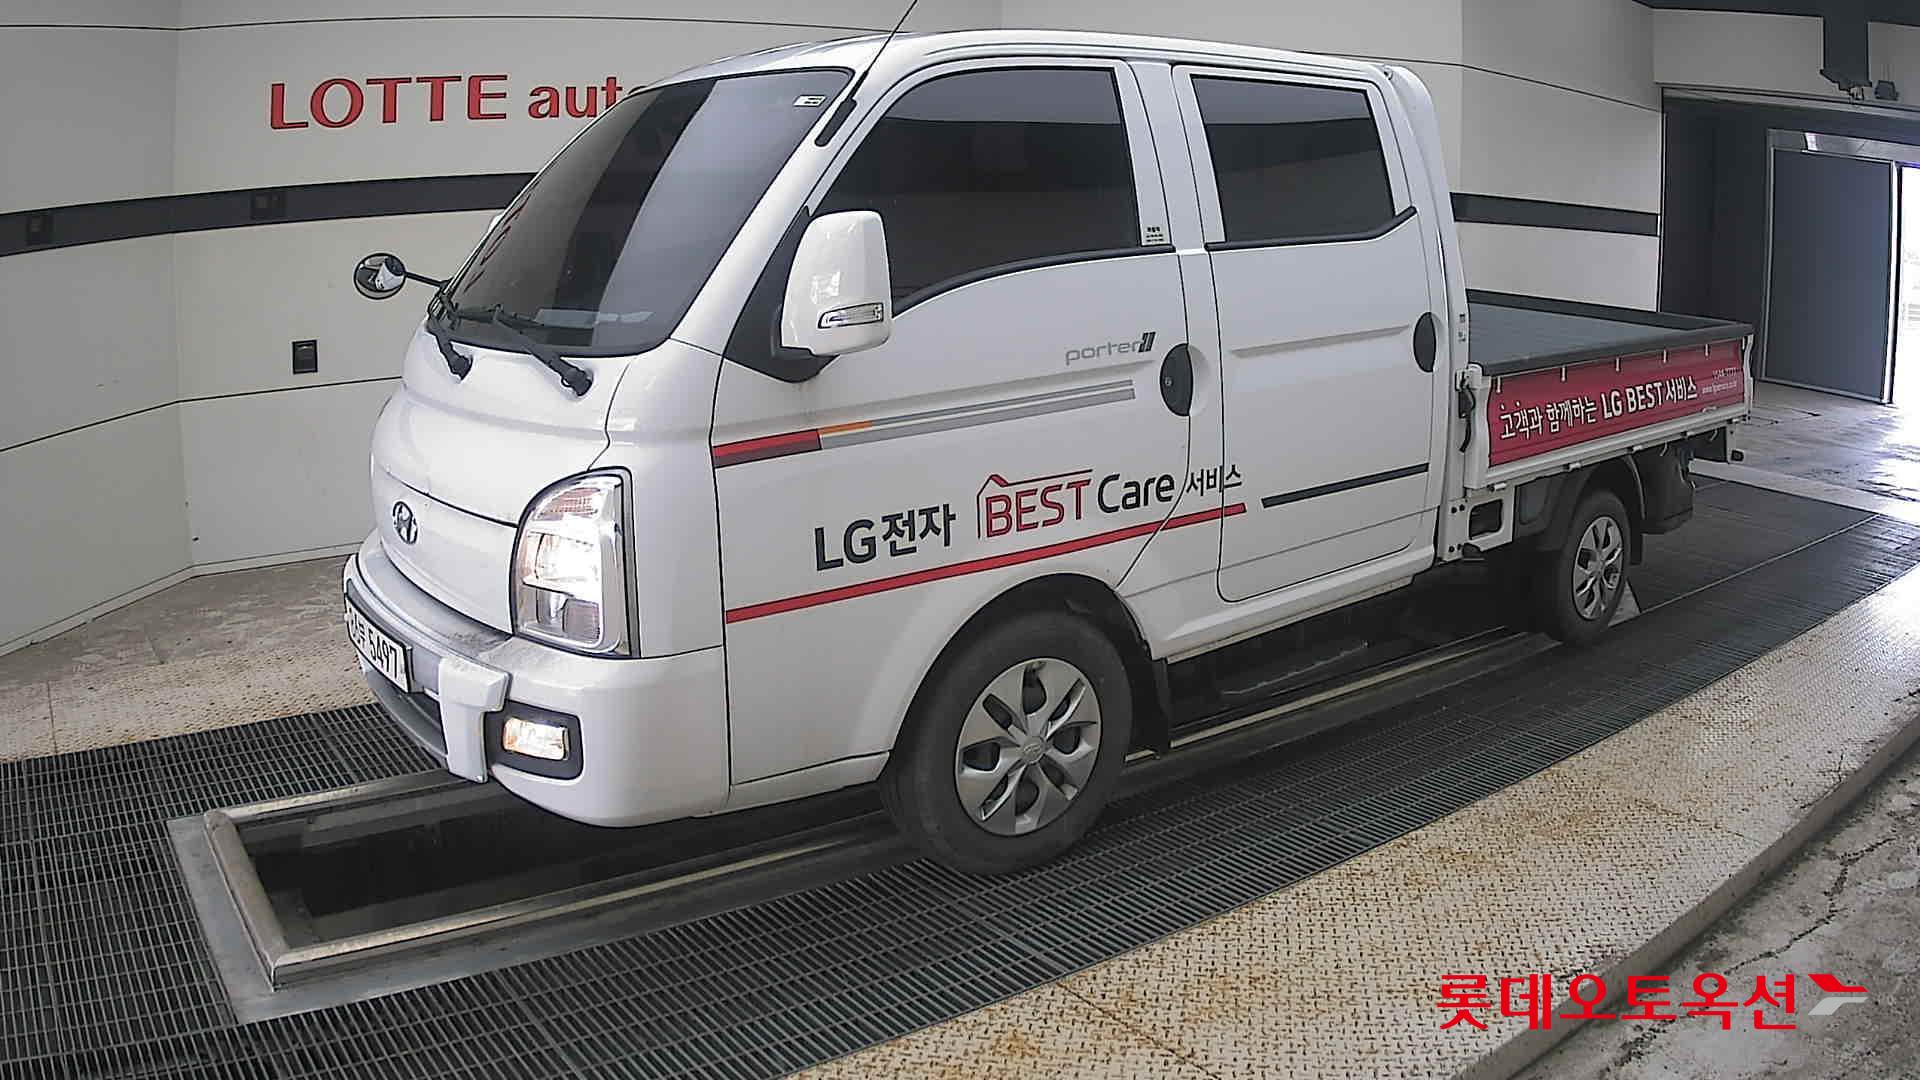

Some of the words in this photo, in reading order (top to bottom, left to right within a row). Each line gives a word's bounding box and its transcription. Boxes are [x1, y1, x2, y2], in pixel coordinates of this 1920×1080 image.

[270, 74, 508, 130] LOTTE
[527, 76, 649, 119] aut
[1500, 403, 1543, 440] 고객과
[1546, 396, 1598, 433] 함께하는
[1601, 390, 1622, 419] LG
[1625, 381, 1663, 413] BEST
[1665, 375, 1698, 404] 서비스
[985, 478, 1092, 538] BEST
[1097, 472, 1175, 514] Care
[1186, 464, 1242, 497] 서비스
[367, 626, 399, 681] 5497
